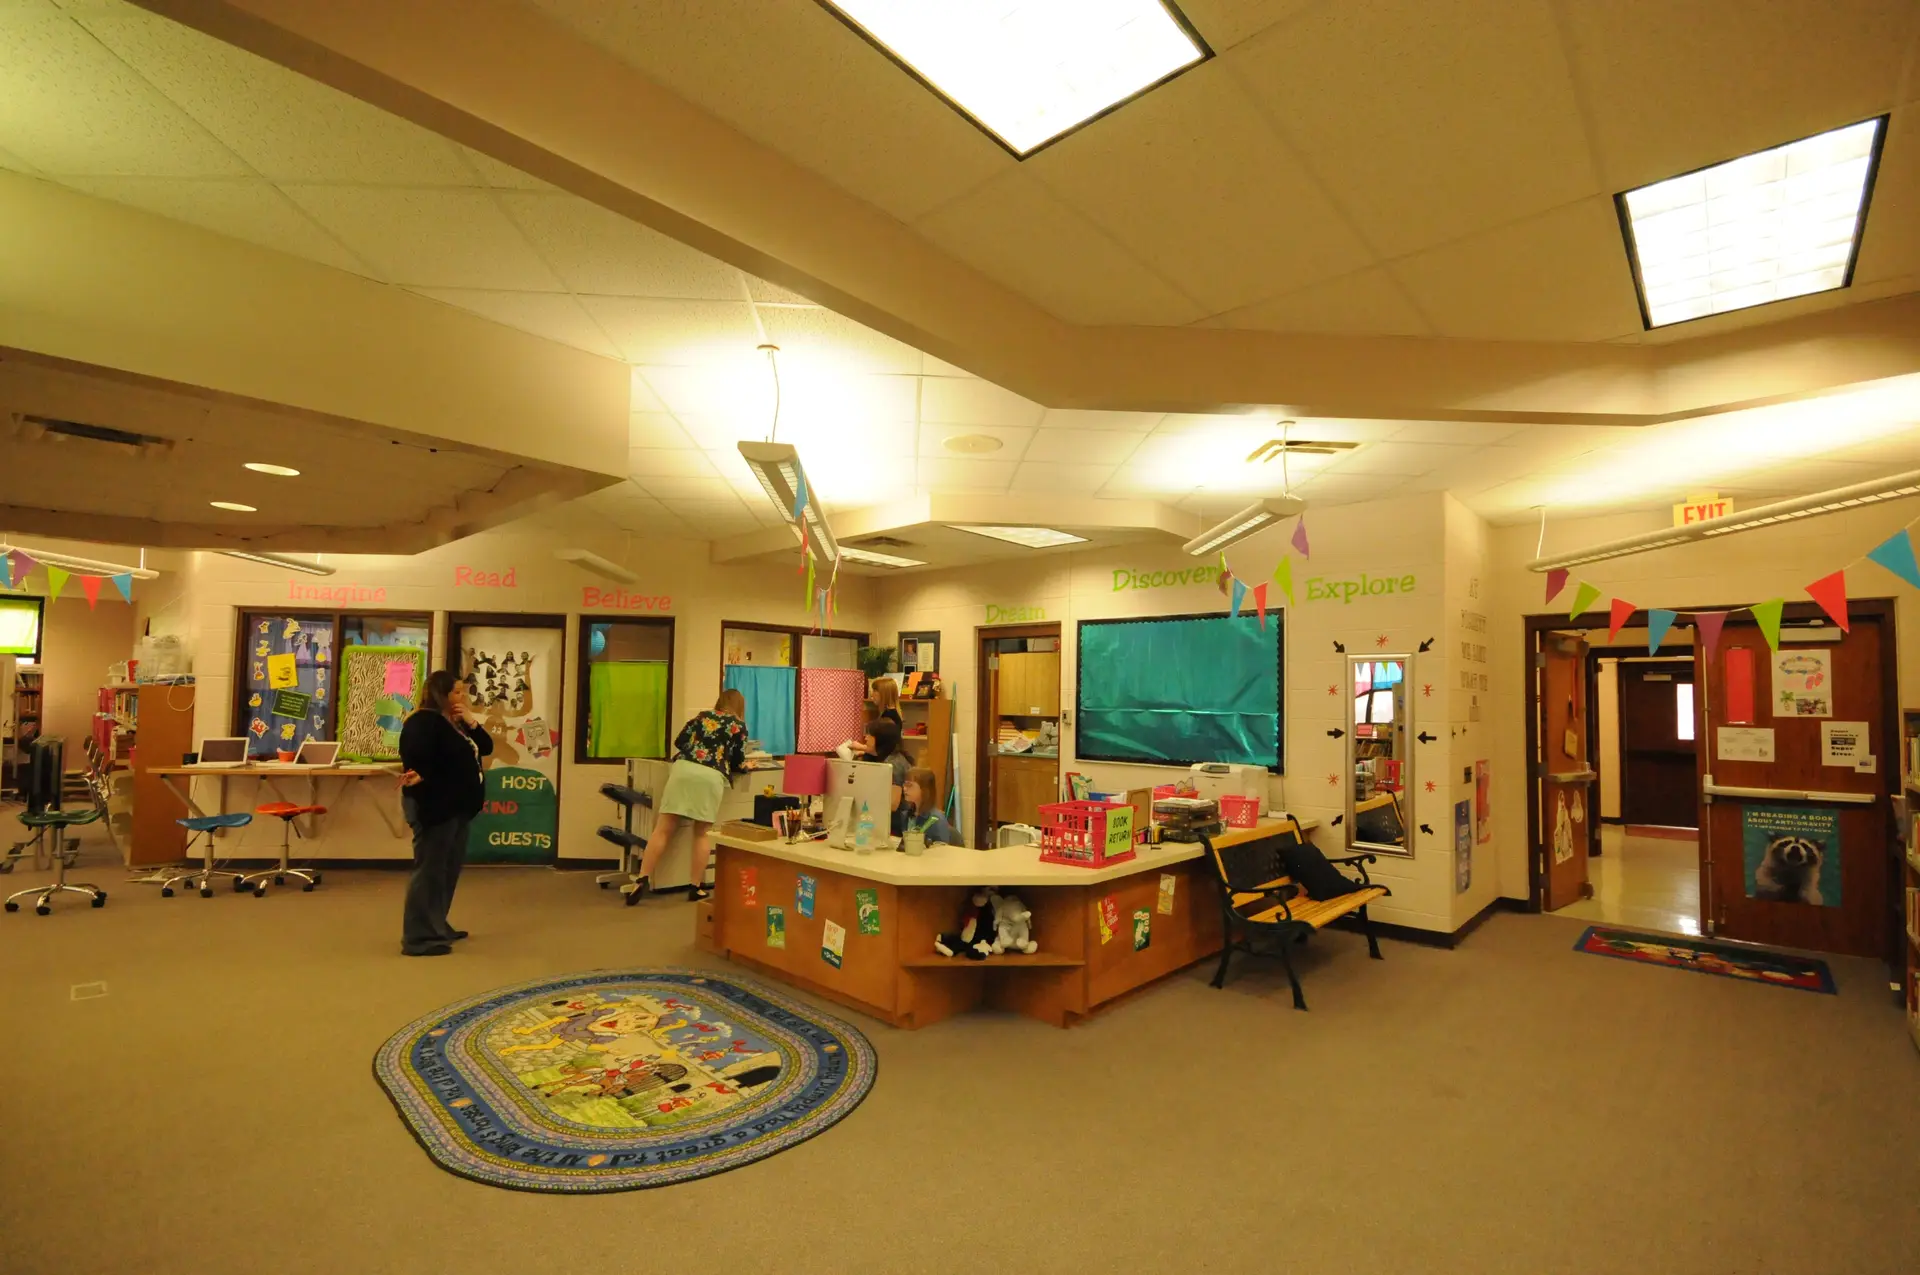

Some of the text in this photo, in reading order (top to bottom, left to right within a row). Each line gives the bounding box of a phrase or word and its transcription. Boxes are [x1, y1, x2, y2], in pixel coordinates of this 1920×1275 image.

[1683, 502, 1726, 525] EXIT
[454, 565, 517, 588] Read
[1112, 564, 1222, 593] Discover
[286, 579, 387, 609] Imagine
[581, 586, 672, 611] Believe
[1304, 572, 1416, 605] Explore
[984, 604, 1045, 624] Dream
[501, 775, 547, 790] HOST
[1112, 816, 1129, 829] BOOK
[488, 831, 551, 849] GUESTS
[1108, 830, 1132, 844] RETURN
[460, 1104, 488, 1134] horses
[752, 1109, 790, 1133] had
[732, 1130, 748, 1139] a
[521, 1148, 557, 1163] the
[656, 1134, 727, 1161] great
[609, 1153, 648, 1167] fall
